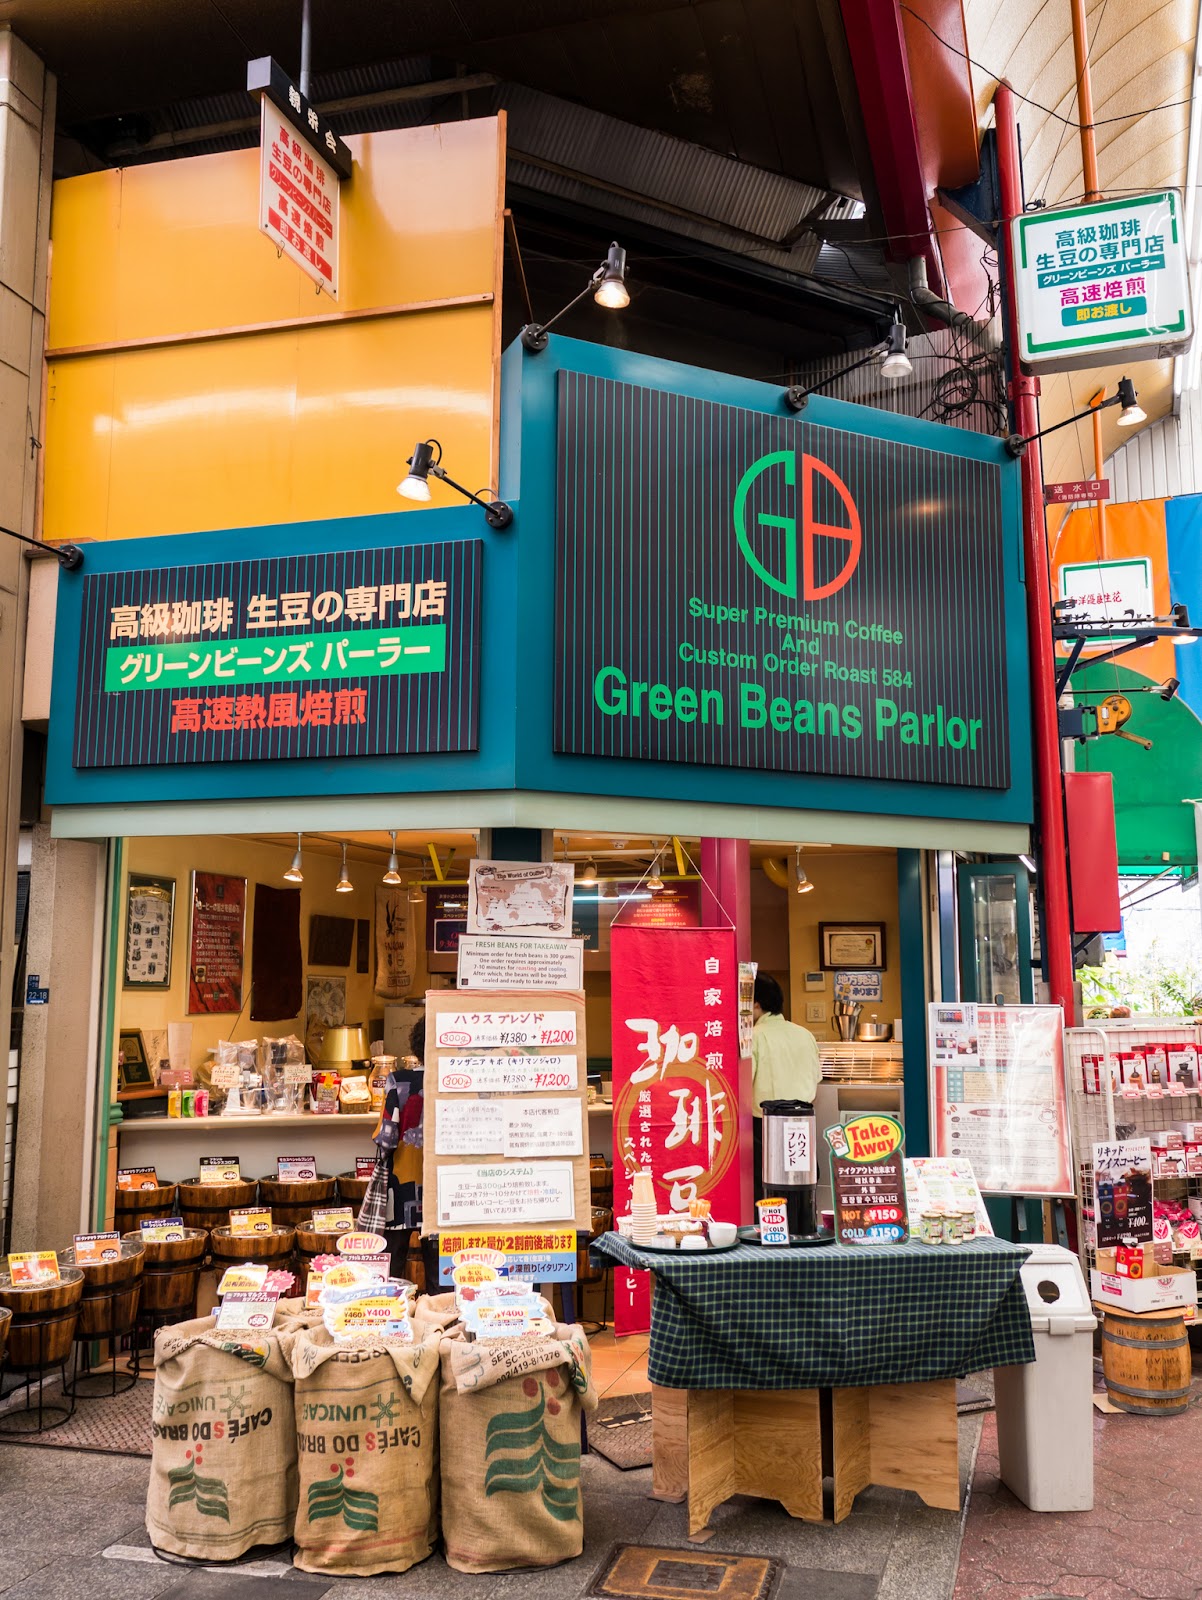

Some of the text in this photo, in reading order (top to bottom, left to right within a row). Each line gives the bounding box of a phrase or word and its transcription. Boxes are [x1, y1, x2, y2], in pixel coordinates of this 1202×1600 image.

[280, 125, 326, 187] 高級珈琲
[272, 142, 332, 216] 生豆の専門店
[278, 193, 324, 252] 高速焙煎
[280, 219, 322, 268] 即お渡し
[1056, 219, 1140, 248] 高級珈琲
[1036, 235, 1164, 271] 生豆の専門店
[1043, 264, 1116, 285] グリーンビーンズ
[1060, 277, 1146, 306] 高速焙煎
[1076, 302, 1132, 322] 即お渡し
[1054, 482, 1100, 494] 送水口
[110, 580, 447, 640] 高級珈琲 生豆の専門店
[688, 596, 903, 645] Super Premium Coffee
[782, 632, 820, 656] And
[120, 637, 431, 684] グリーンビーンズ パーラー
[678, 642, 913, 688] Custom Order Roast 584
[171, 688, 367, 734] 高速熱風焙煎
[594, 666, 982, 750] Green Beans Parlor
[836, 973, 880, 986] 地方発送
[852, 987, 880, 996] 承ります
[454, 1013, 544, 1024] ハウス ブレンド
[704, 956, 724, 1070] 自家焙煎
[500, 1032, 528, 1044] ¥1,380
[540, 1030, 574, 1044] ¥1,200
[450, 1058, 486, 1066] タンザニア
[503, 1074, 526, 1083] ¥1,380
[535, 1073, 570, 1088] ¥1,200
[624, 1018, 727, 1213] 珈琲豆
[848, 1122, 890, 1140] Take
[798, 1133, 806, 1157] ハウス
[853, 1138, 894, 1158] Away
[1098, 1145, 1124, 1157] リキッド
[838, 1166, 896, 1174] テイクアウト出来ます
[1098, 1156, 1147, 1169] アイスコーヒー
[842, 1210, 897, 1220] HOT ¥150
[1127, 1216, 1146, 1228] ¥400
[442, 1234, 572, 1252] 焙煎しますと量が2割前後減ります
[842, 1228, 899, 1238] COLD ¥150
[344, 1238, 379, 1249] NEW!
[367, 1309, 391, 1317] ¥400
[192, 1422, 211, 1441] DO
[332, 1434, 360, 1452] DO
